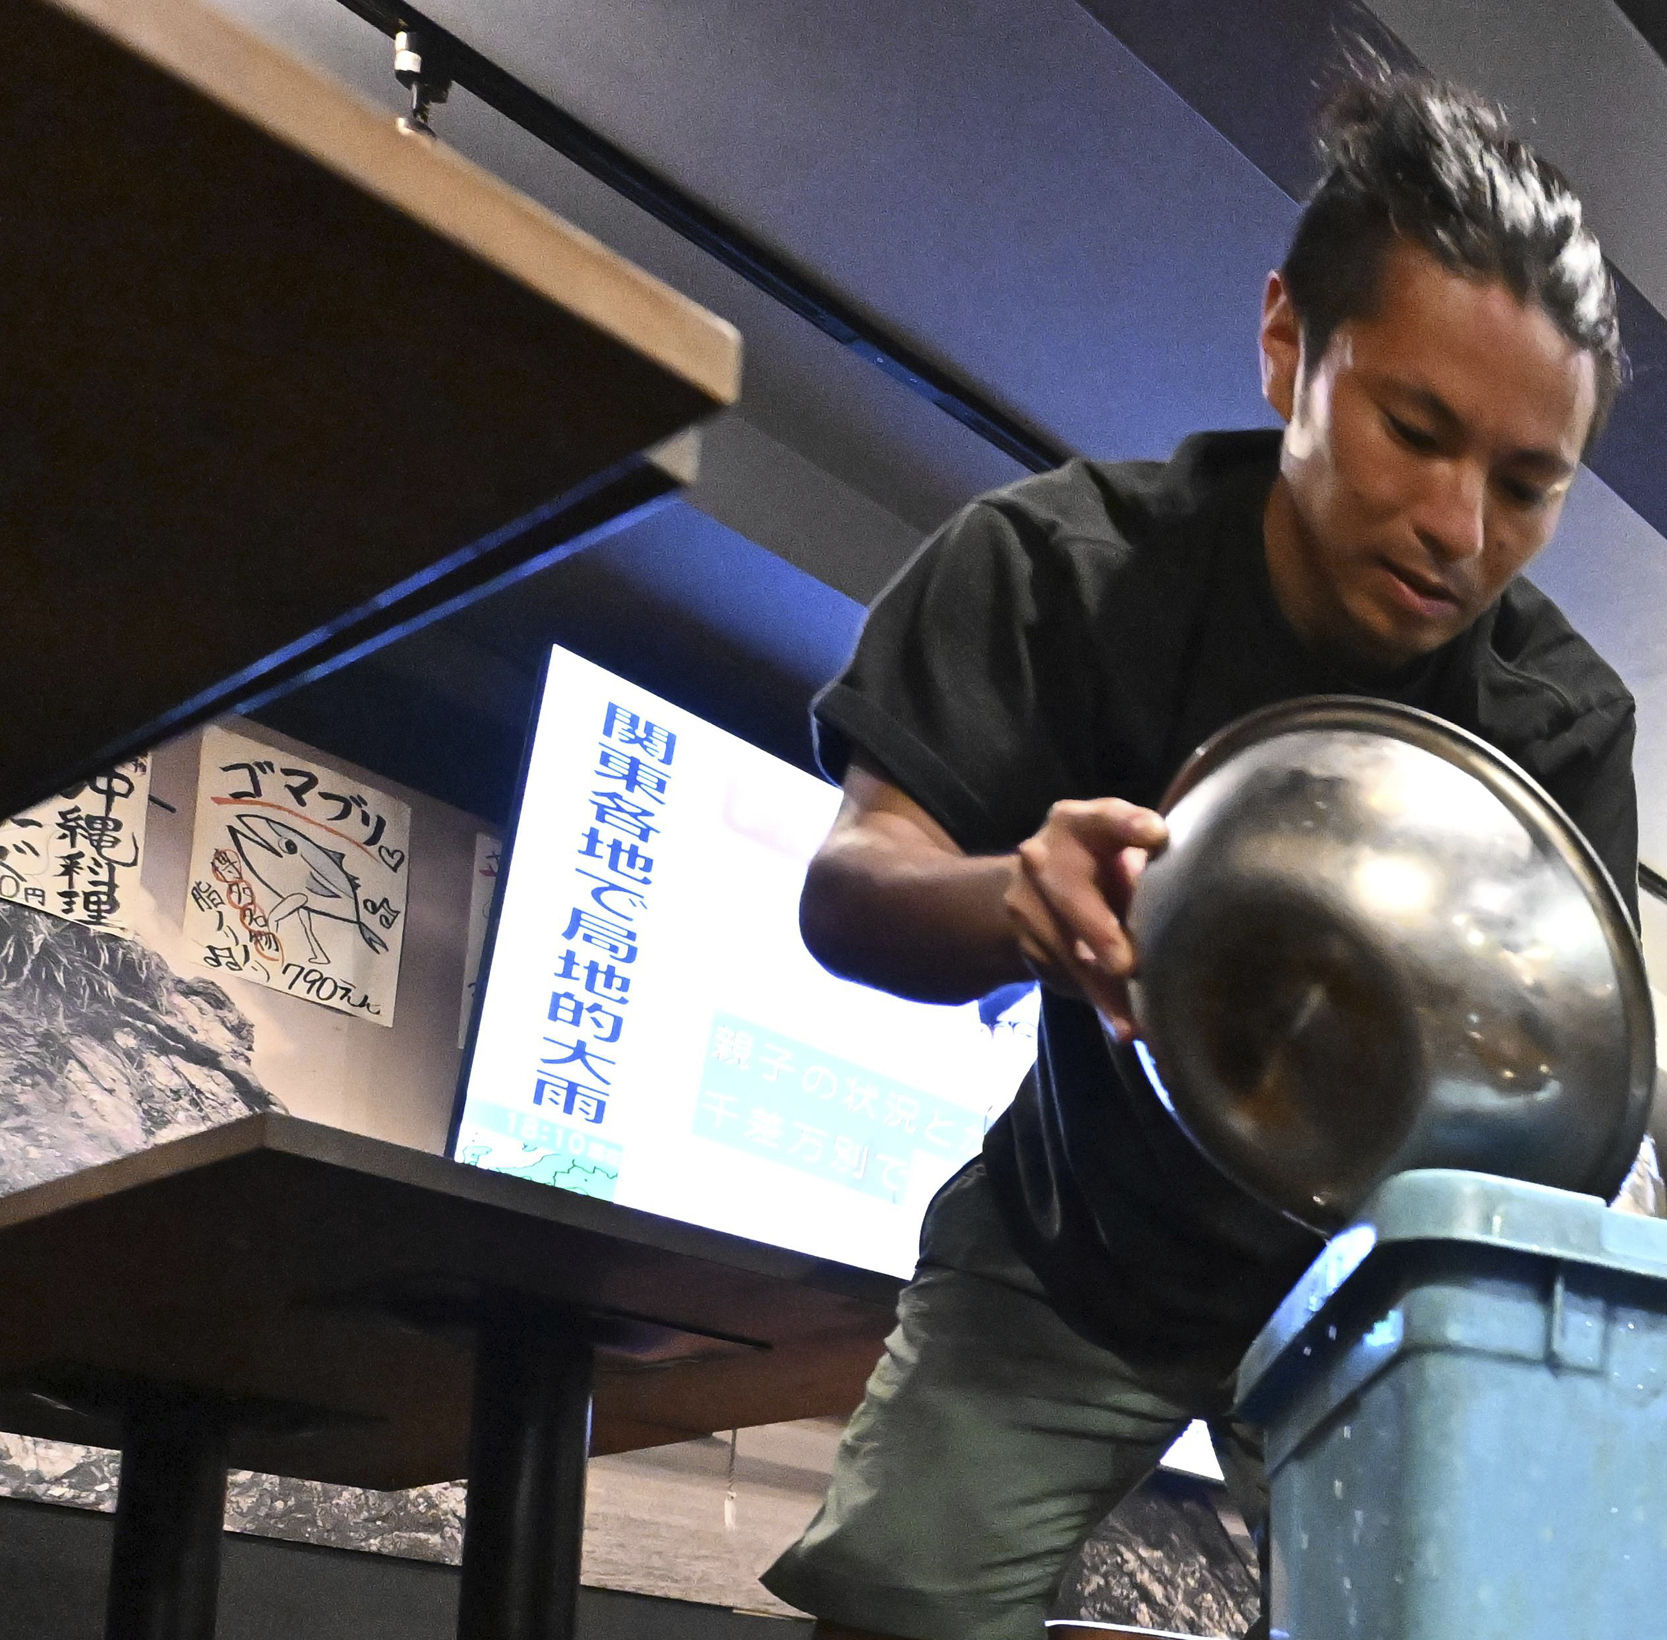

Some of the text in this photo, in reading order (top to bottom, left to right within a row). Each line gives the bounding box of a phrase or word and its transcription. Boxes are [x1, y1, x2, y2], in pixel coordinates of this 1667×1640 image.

[219, 760, 387, 847] ゴマブリ
[532, 700, 678, 1125] 関東各地で局地的大雨
